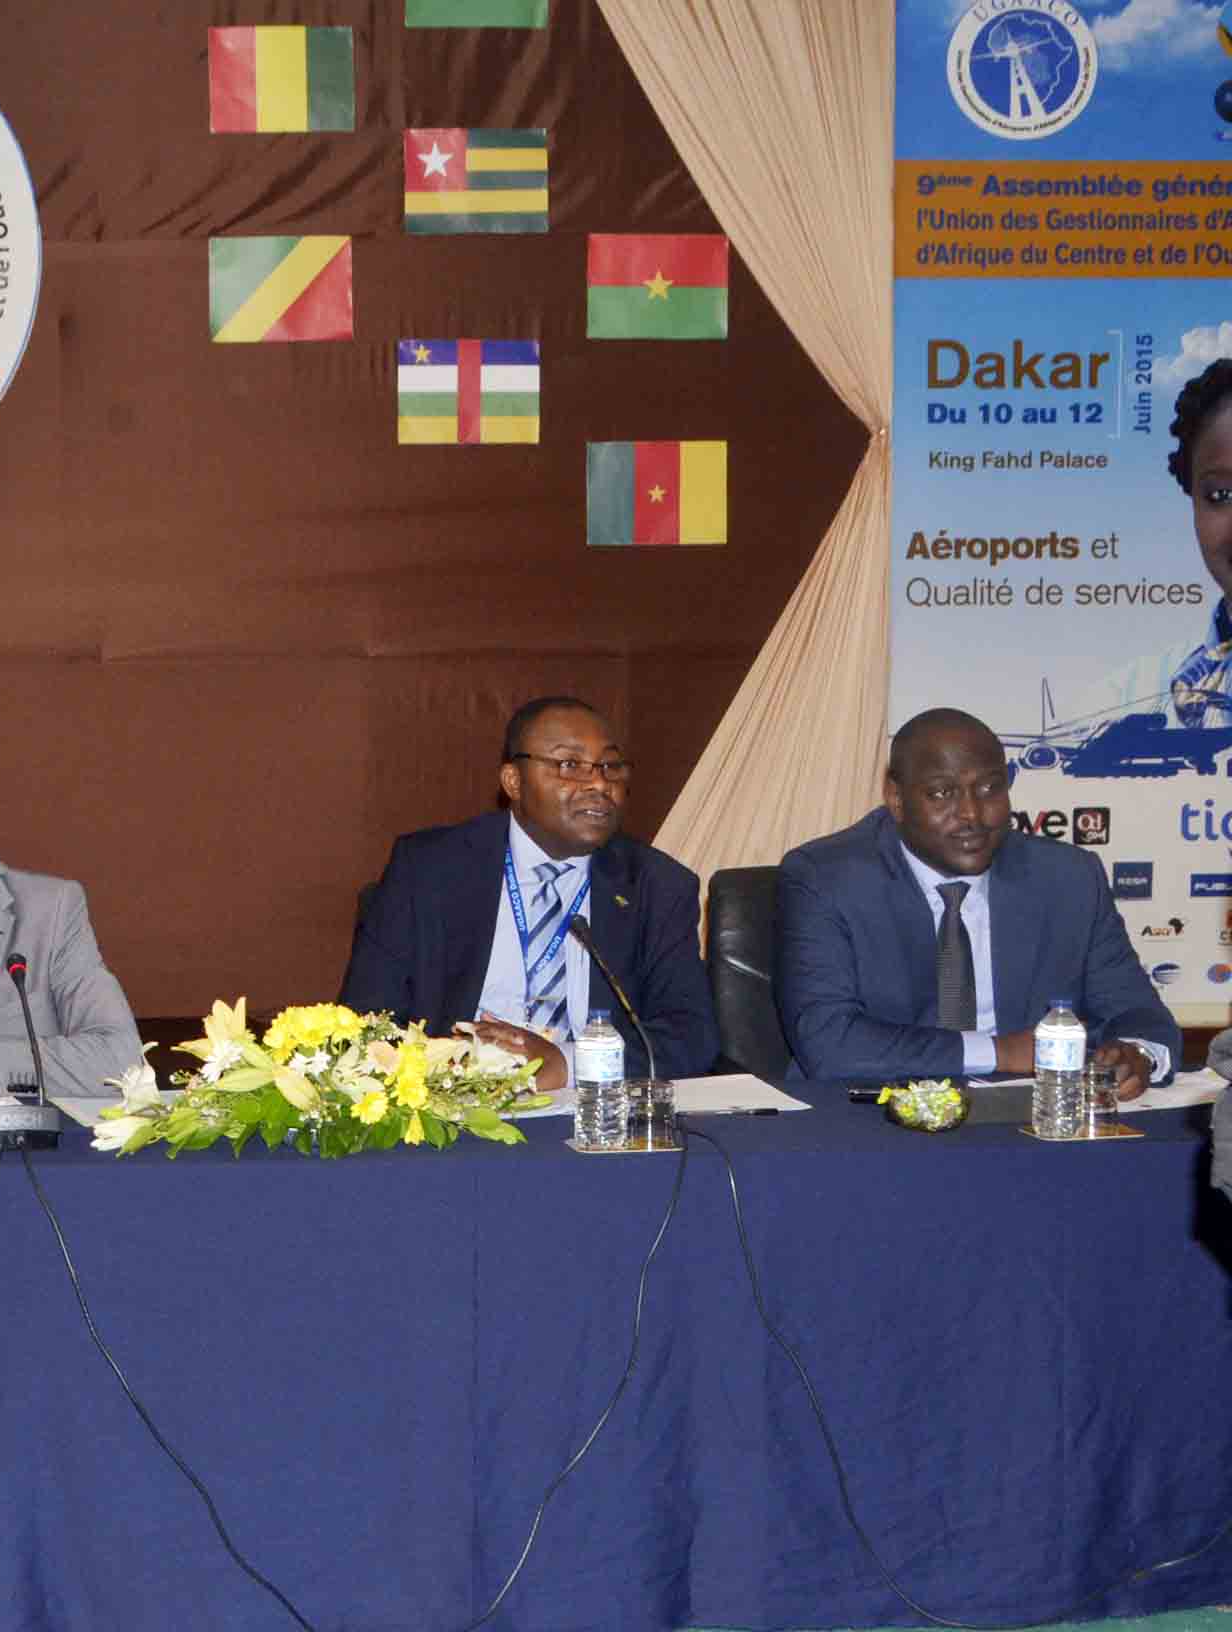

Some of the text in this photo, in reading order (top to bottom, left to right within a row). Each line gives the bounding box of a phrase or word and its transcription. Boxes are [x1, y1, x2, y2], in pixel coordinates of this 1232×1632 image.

[982, 174, 1144, 197] Assemblée
[918, 207, 993, 231] l'Union
[1000, 207, 1040, 231] des
[1046, 207, 1199, 231] Gestionnaires
[917, 242, 1014, 269] d'Afrique
[1020, 242, 1049, 265] du
[1055, 242, 1127, 265] Centre
[1132, 243, 1153, 265] et
[1161, 242, 1188, 265] de
[927, 338, 1110, 390] Dakar
[1133, 335, 1153, 434] Juin 2015
[927, 403, 1103, 425] Du 10 au 12
[929, 451, 1109, 472] King Fahd Palace
[906, 530, 1120, 566] Aéroports et
[906, 577, 1204, 607] Qualité de services
